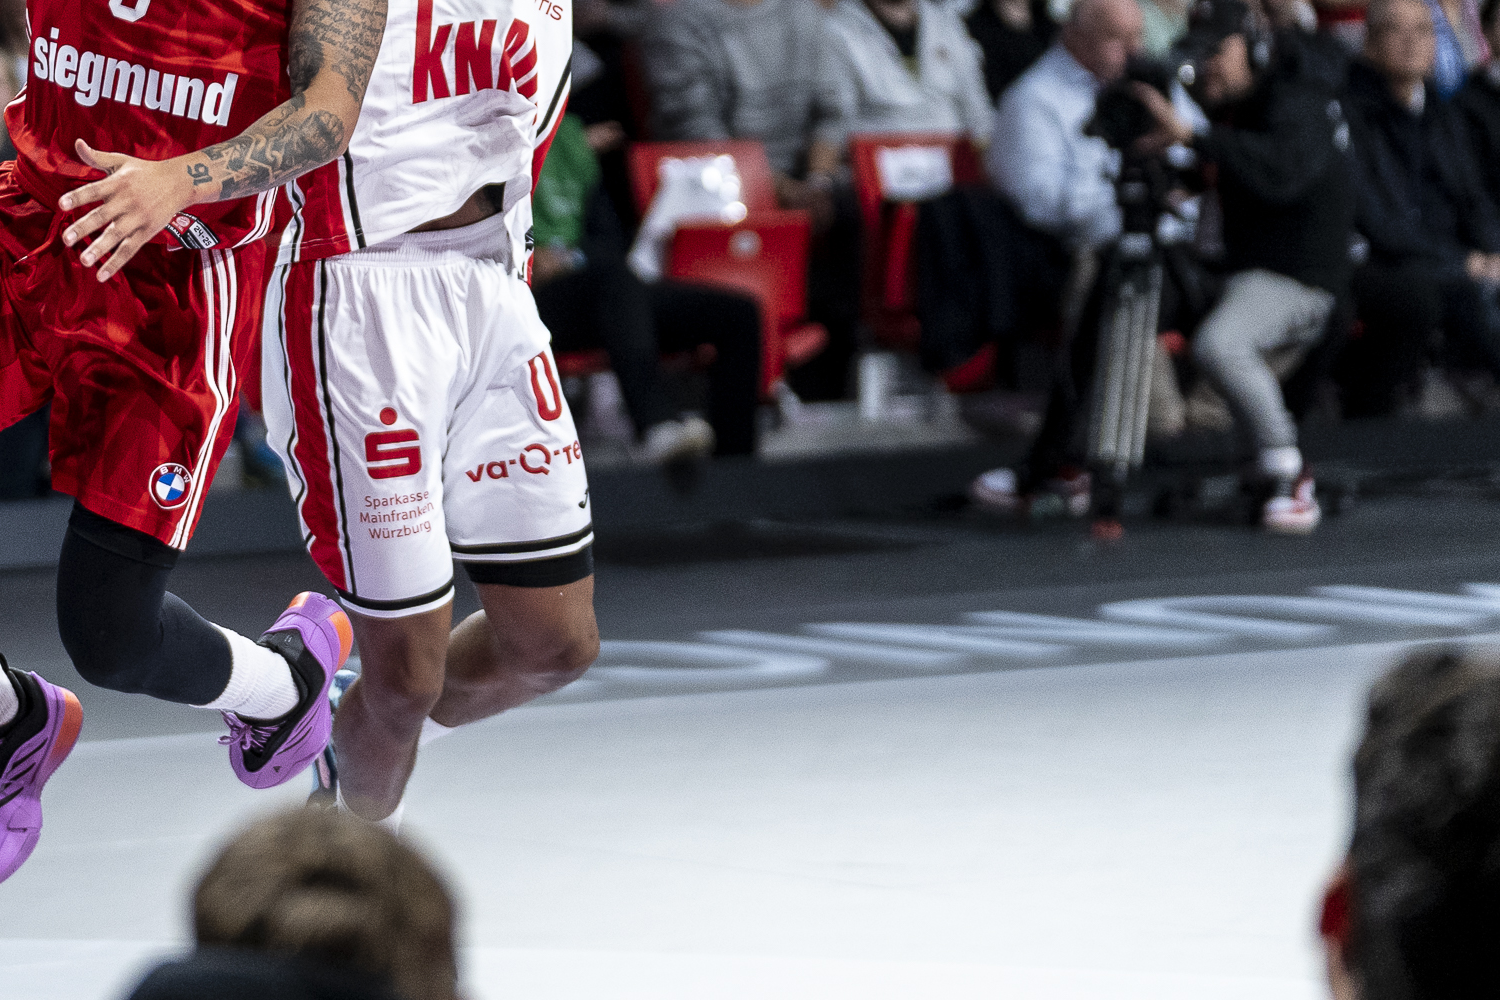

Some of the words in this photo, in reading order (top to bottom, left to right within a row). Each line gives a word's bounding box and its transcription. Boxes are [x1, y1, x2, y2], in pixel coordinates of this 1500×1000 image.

[34, 27, 238, 127] siegmund
[193, 225, 213, 247] 24-25
[160, 465, 190, 483] BMW
[364, 490, 430, 510] Sparkasse
[359, 501, 435, 524] Mainfranken
[368, 520, 432, 540] Würzburg
